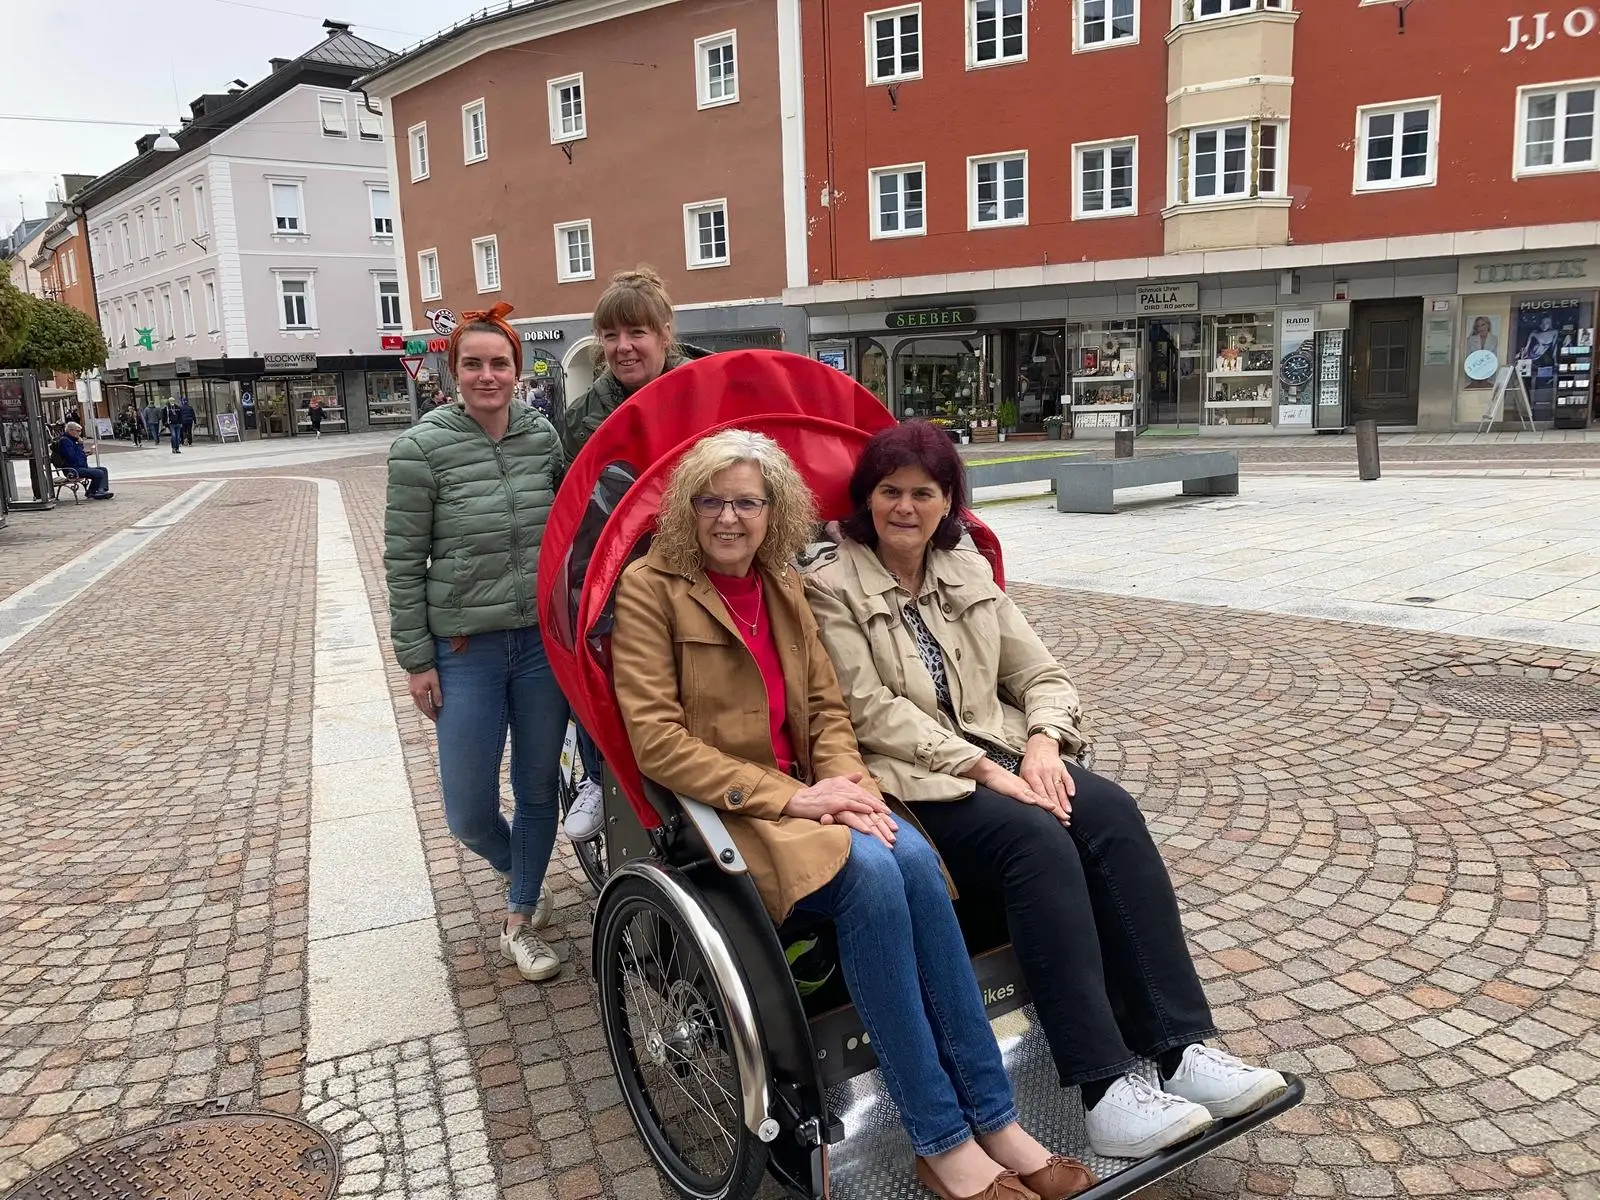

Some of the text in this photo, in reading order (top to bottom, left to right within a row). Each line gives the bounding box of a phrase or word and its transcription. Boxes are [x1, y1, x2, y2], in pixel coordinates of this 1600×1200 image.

[1499, 6, 1600, 54] J.J. O
[1473, 258, 1588, 284] DOUGLAS
[1140, 292, 1178, 304] PALLA
[1520, 299, 1579, 310] MUGLER
[896, 311, 962, 327] SEEBER
[524, 329, 561, 341] DOBNIG
[264, 354, 316, 362] KLOCKWERK
[983, 983, 1015, 1006] ikes
